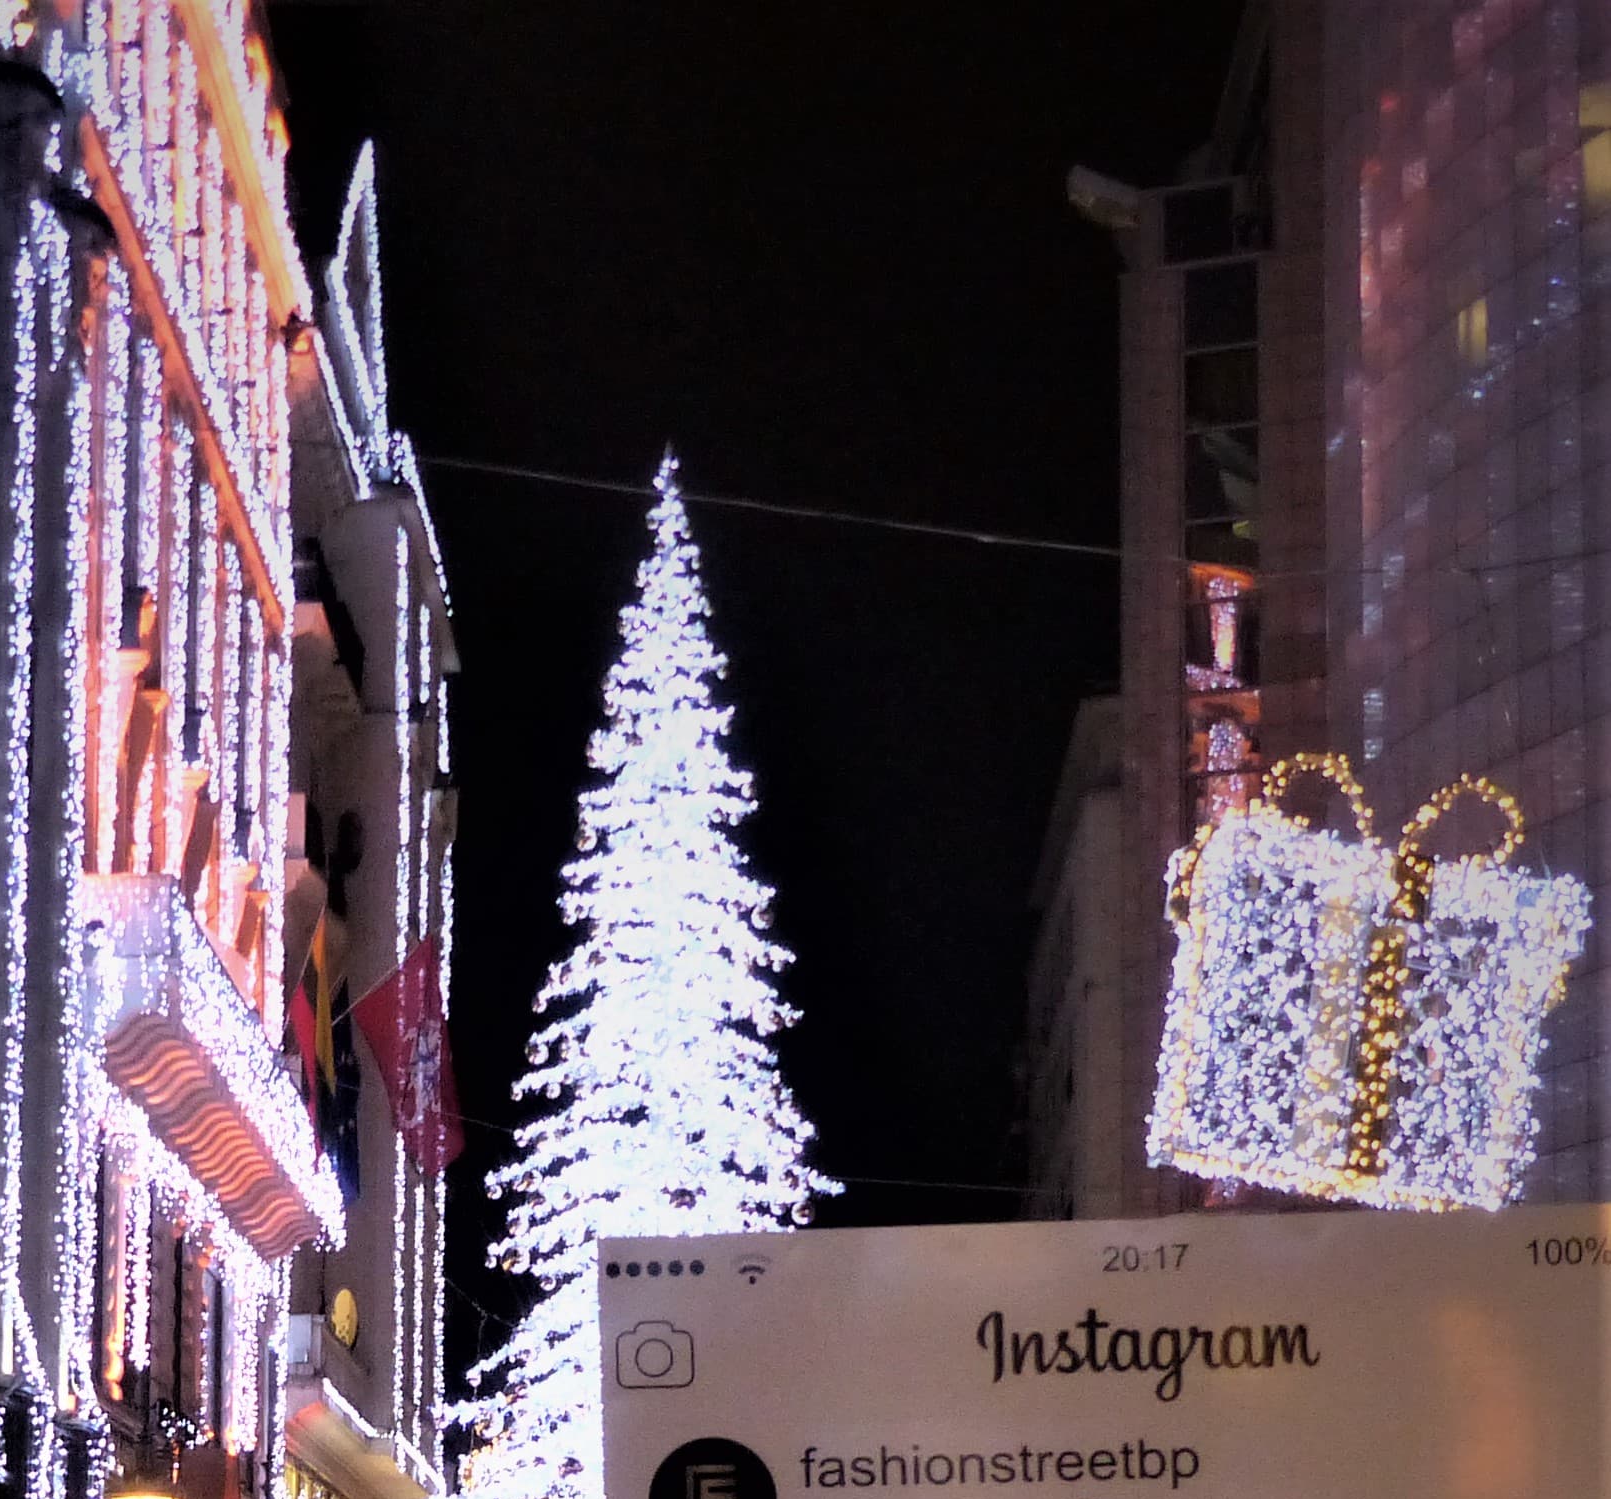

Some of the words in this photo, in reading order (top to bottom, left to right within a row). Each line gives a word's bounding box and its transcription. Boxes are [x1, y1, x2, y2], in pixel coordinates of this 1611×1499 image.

[1102, 1243, 1190, 1273] 20:17
[975, 1307, 1322, 1404] Instagram
[798, 1437, 1200, 1492] fashionstreetbp
